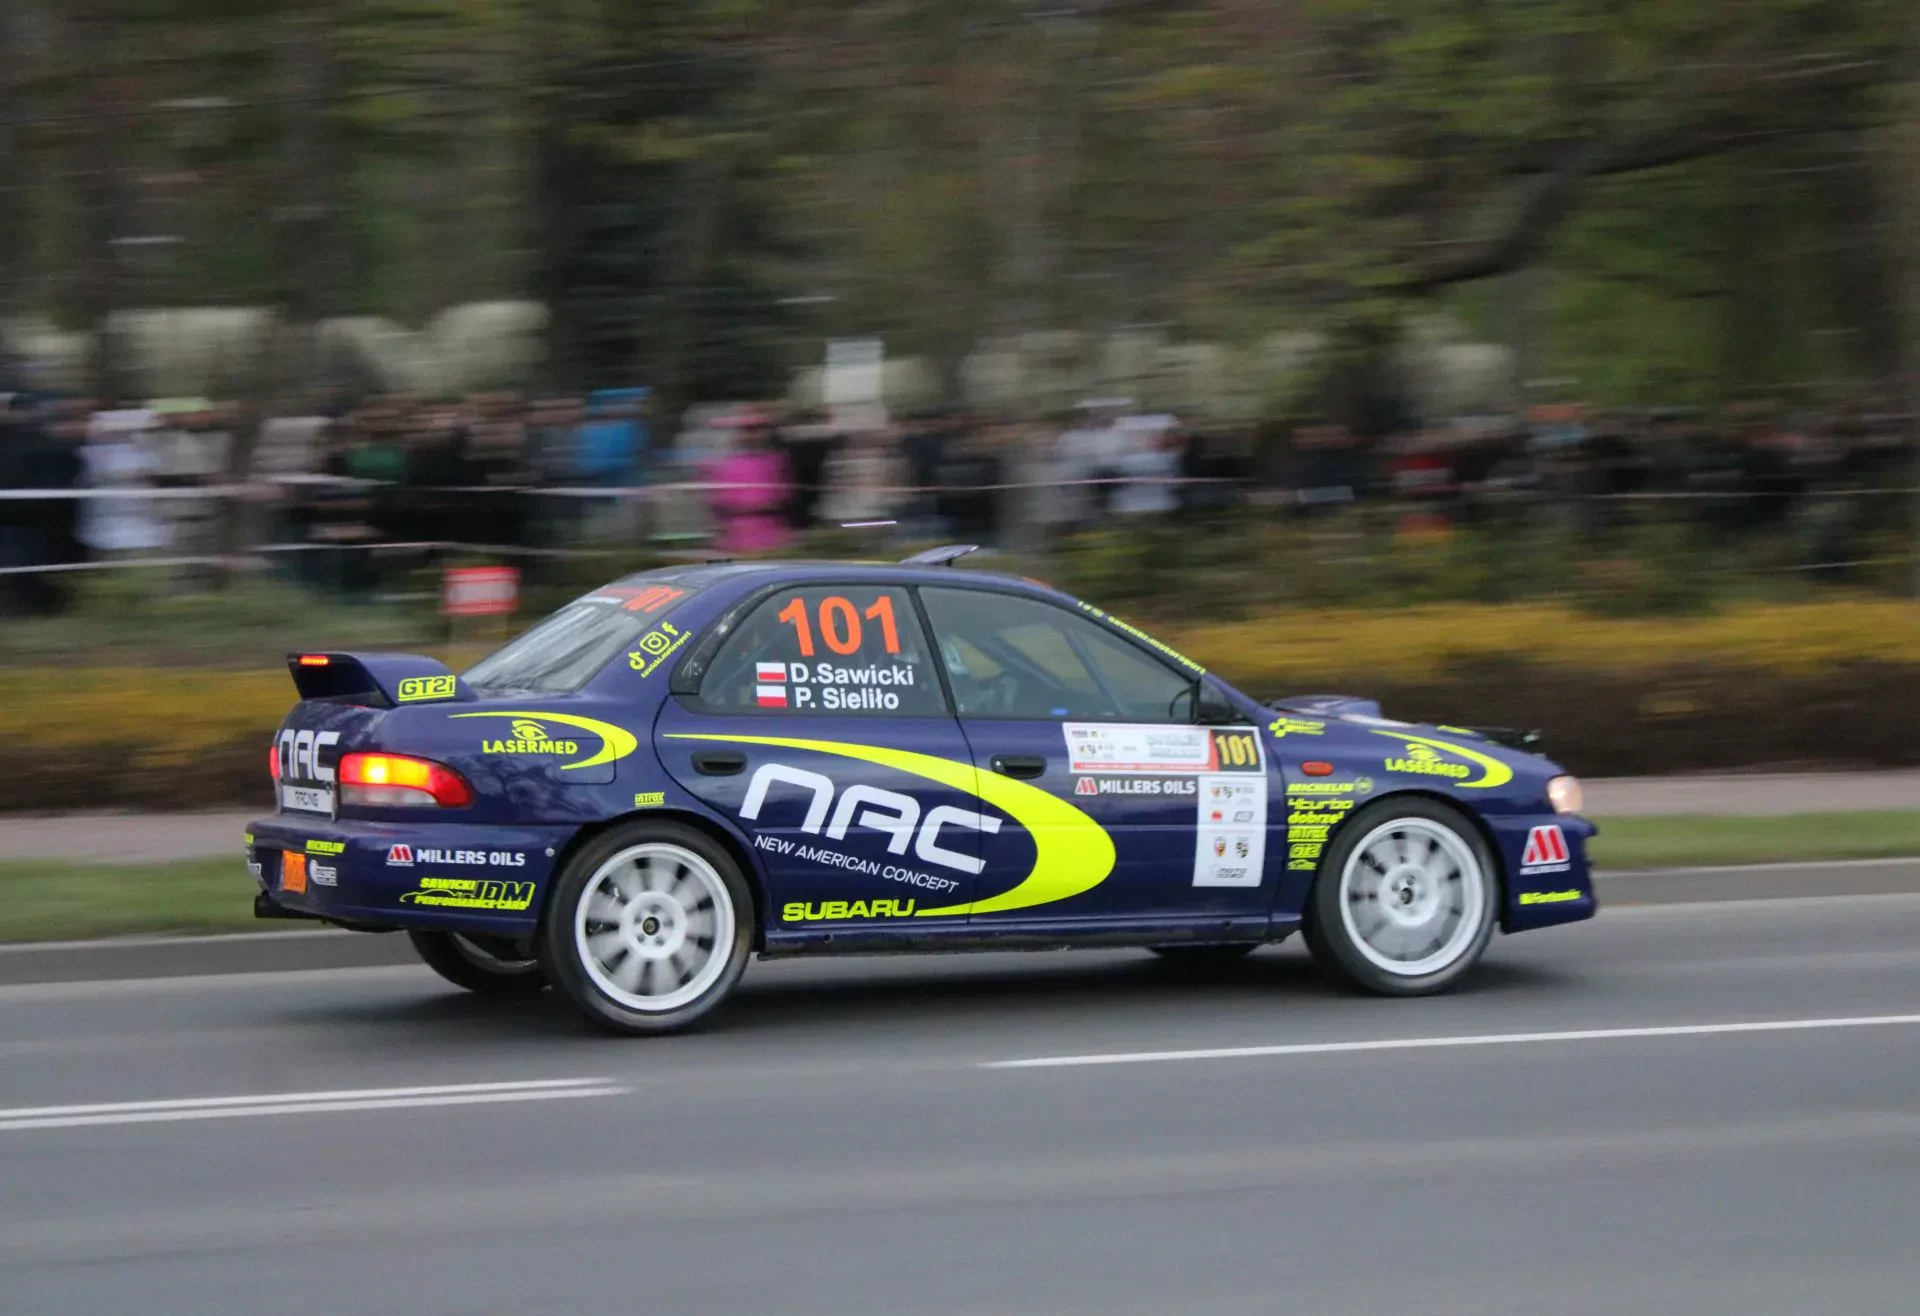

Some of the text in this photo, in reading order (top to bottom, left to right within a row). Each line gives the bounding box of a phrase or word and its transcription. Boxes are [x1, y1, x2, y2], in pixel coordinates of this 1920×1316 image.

[778, 595, 901, 657] 101
[789, 662, 915, 686] D.Sawicki
[400, 678, 456, 697] GT2i
[794, 687, 900, 710] P. Sieliło
[482, 739, 578, 755] LASERMED
[1216, 735, 1257, 766] 101
[1099, 780, 1161, 795] MILLERS
[1164, 780, 1196, 795] OILS
[416, 848, 487, 865] MILLERS
[489, 852, 526, 866] OILS
[754, 834, 961, 895] NEW AMERICAN CONCEPT
[782, 898, 915, 922] SUBARU
